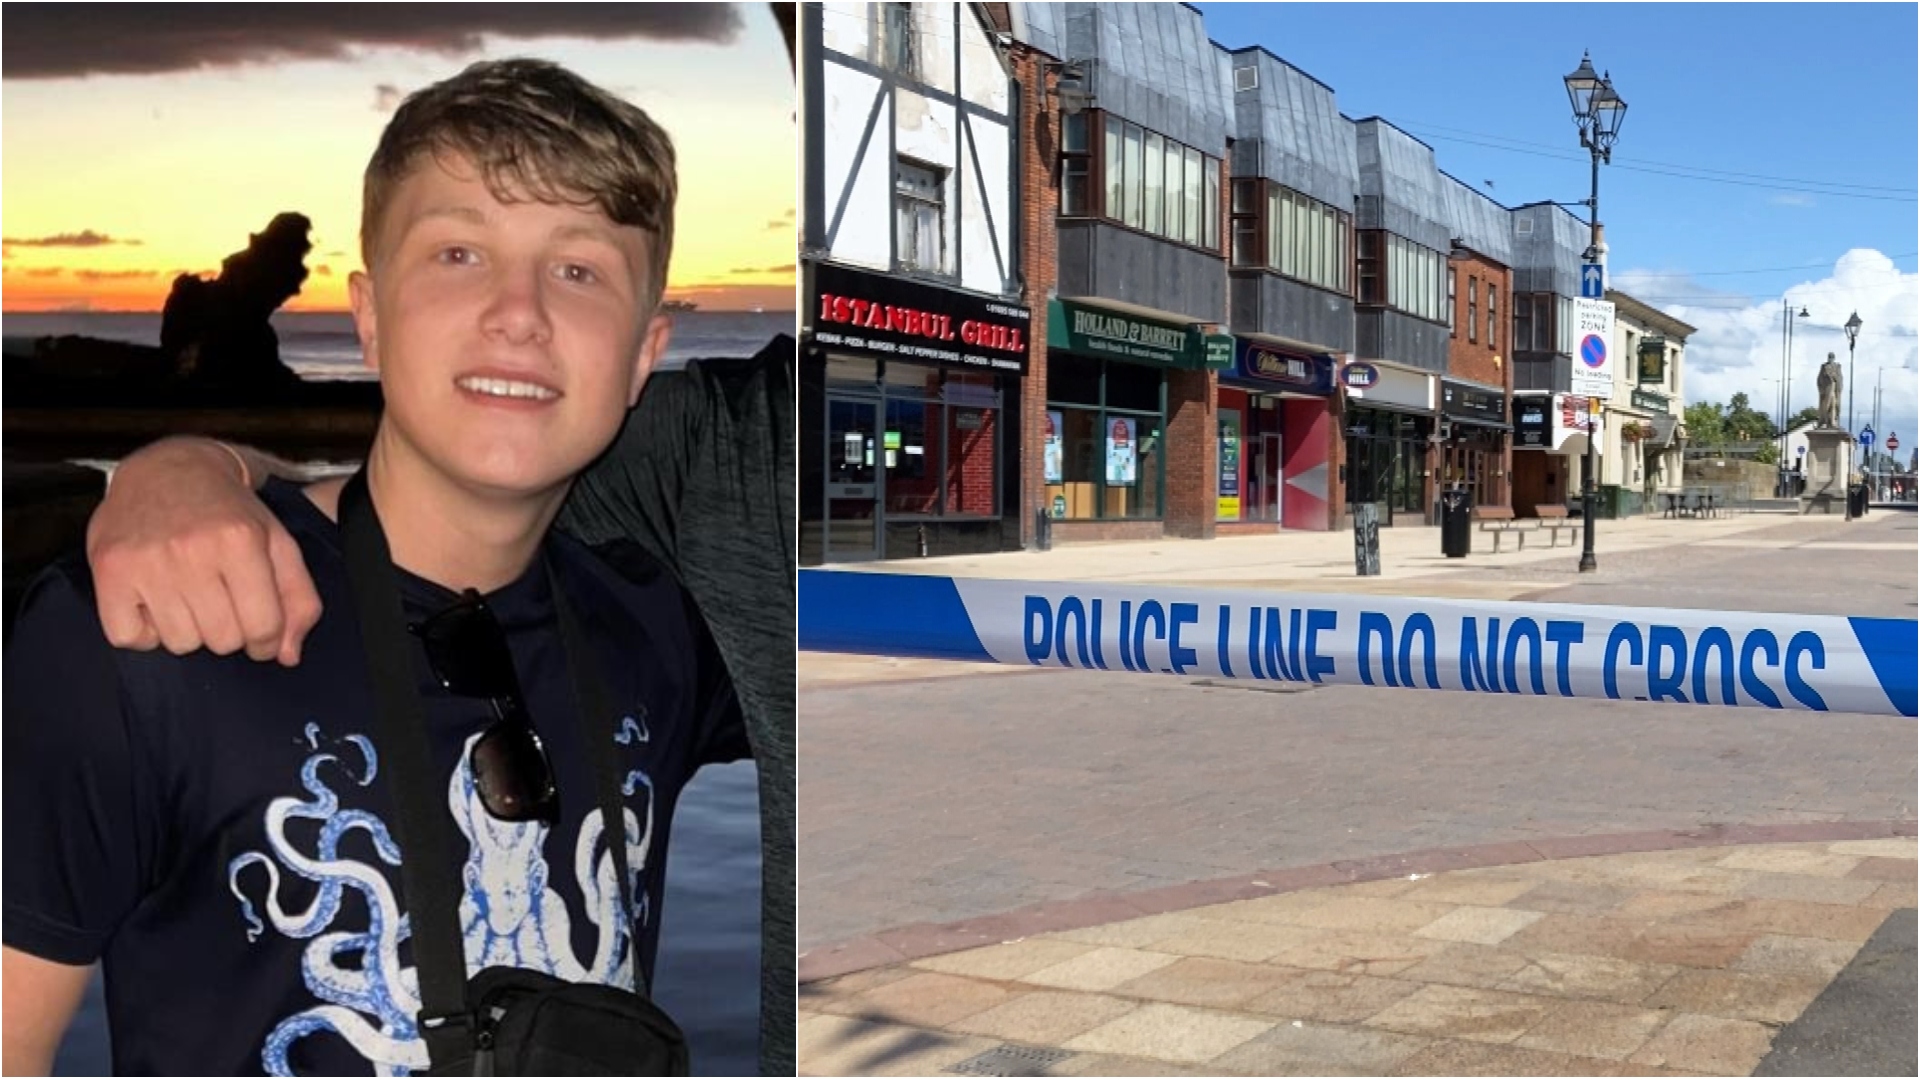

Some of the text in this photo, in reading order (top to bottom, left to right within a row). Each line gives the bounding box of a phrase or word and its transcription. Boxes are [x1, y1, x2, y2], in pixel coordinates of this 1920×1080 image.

[1577, 300, 1612, 313] Restricted
[820, 293, 1025, 352] ISTANBUL GRILL
[1581, 312, 1606, 322] parking
[1074, 310, 1186, 352] HOLLAND & BARRETT
[1581, 320, 1606, 333] ZONE
[816, 332, 842, 345] KEBAB
[845, 336, 864, 348] PIZZA
[868, 340, 896, 352] BURGER
[899, 344, 914, 355] SALT
[915, 347, 938, 359] PEPPER
[938, 350, 960, 361] DISHES
[964, 354, 988, 365] CHICKEN
[1288, 359, 1305, 377] HILL
[1574, 368, 1612, 381] No loading
[1348, 373, 1370, 385] HILL
[1024, 595, 1829, 712] POLICE LINE DO NOT CROSS
